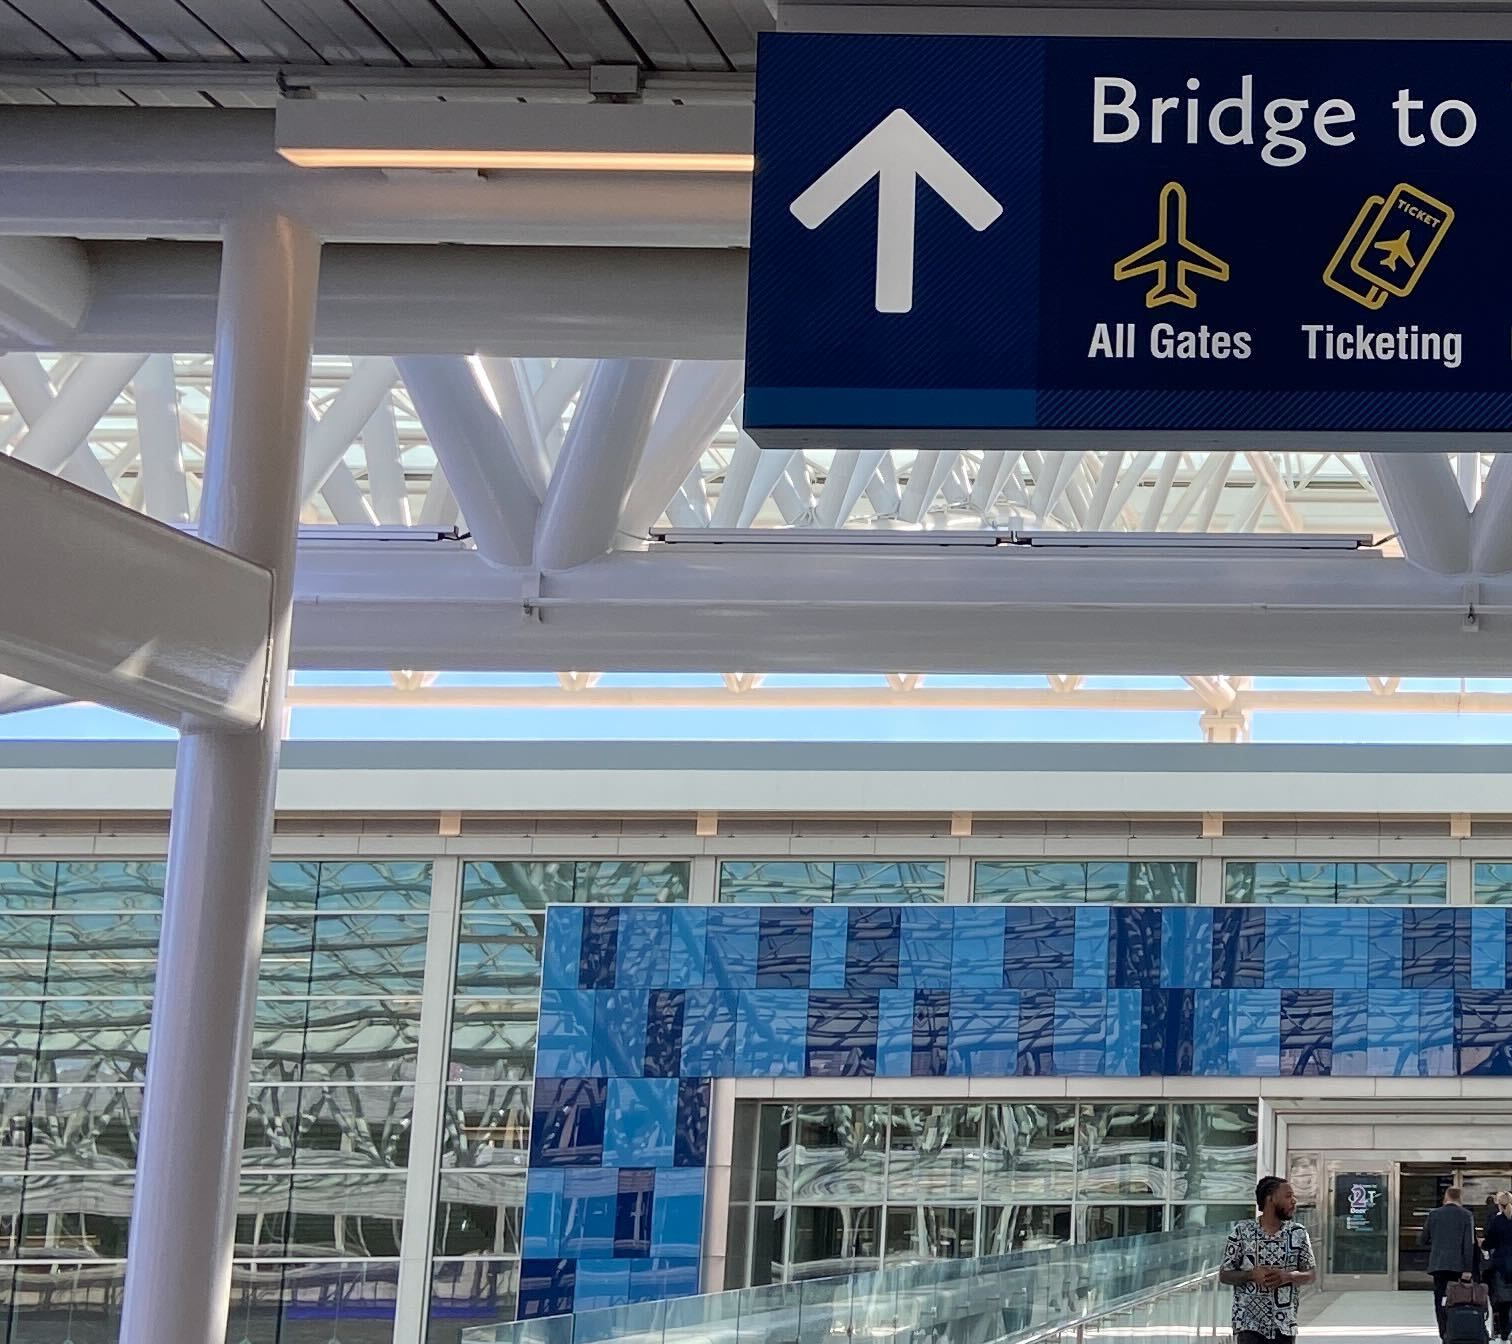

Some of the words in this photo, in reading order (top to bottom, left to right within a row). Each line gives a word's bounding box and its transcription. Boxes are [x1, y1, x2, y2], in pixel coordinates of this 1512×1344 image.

[1092, 74, 1357, 168] Bridge
[1391, 88, 1478, 148] to
[1397, 198, 1441, 229] TICKET
[1087, 322, 1136, 359] All
[1150, 322, 1252, 360] Gates
[1301, 324, 1463, 369] Ticketing
[1351, 1184, 1366, 1207] 2
